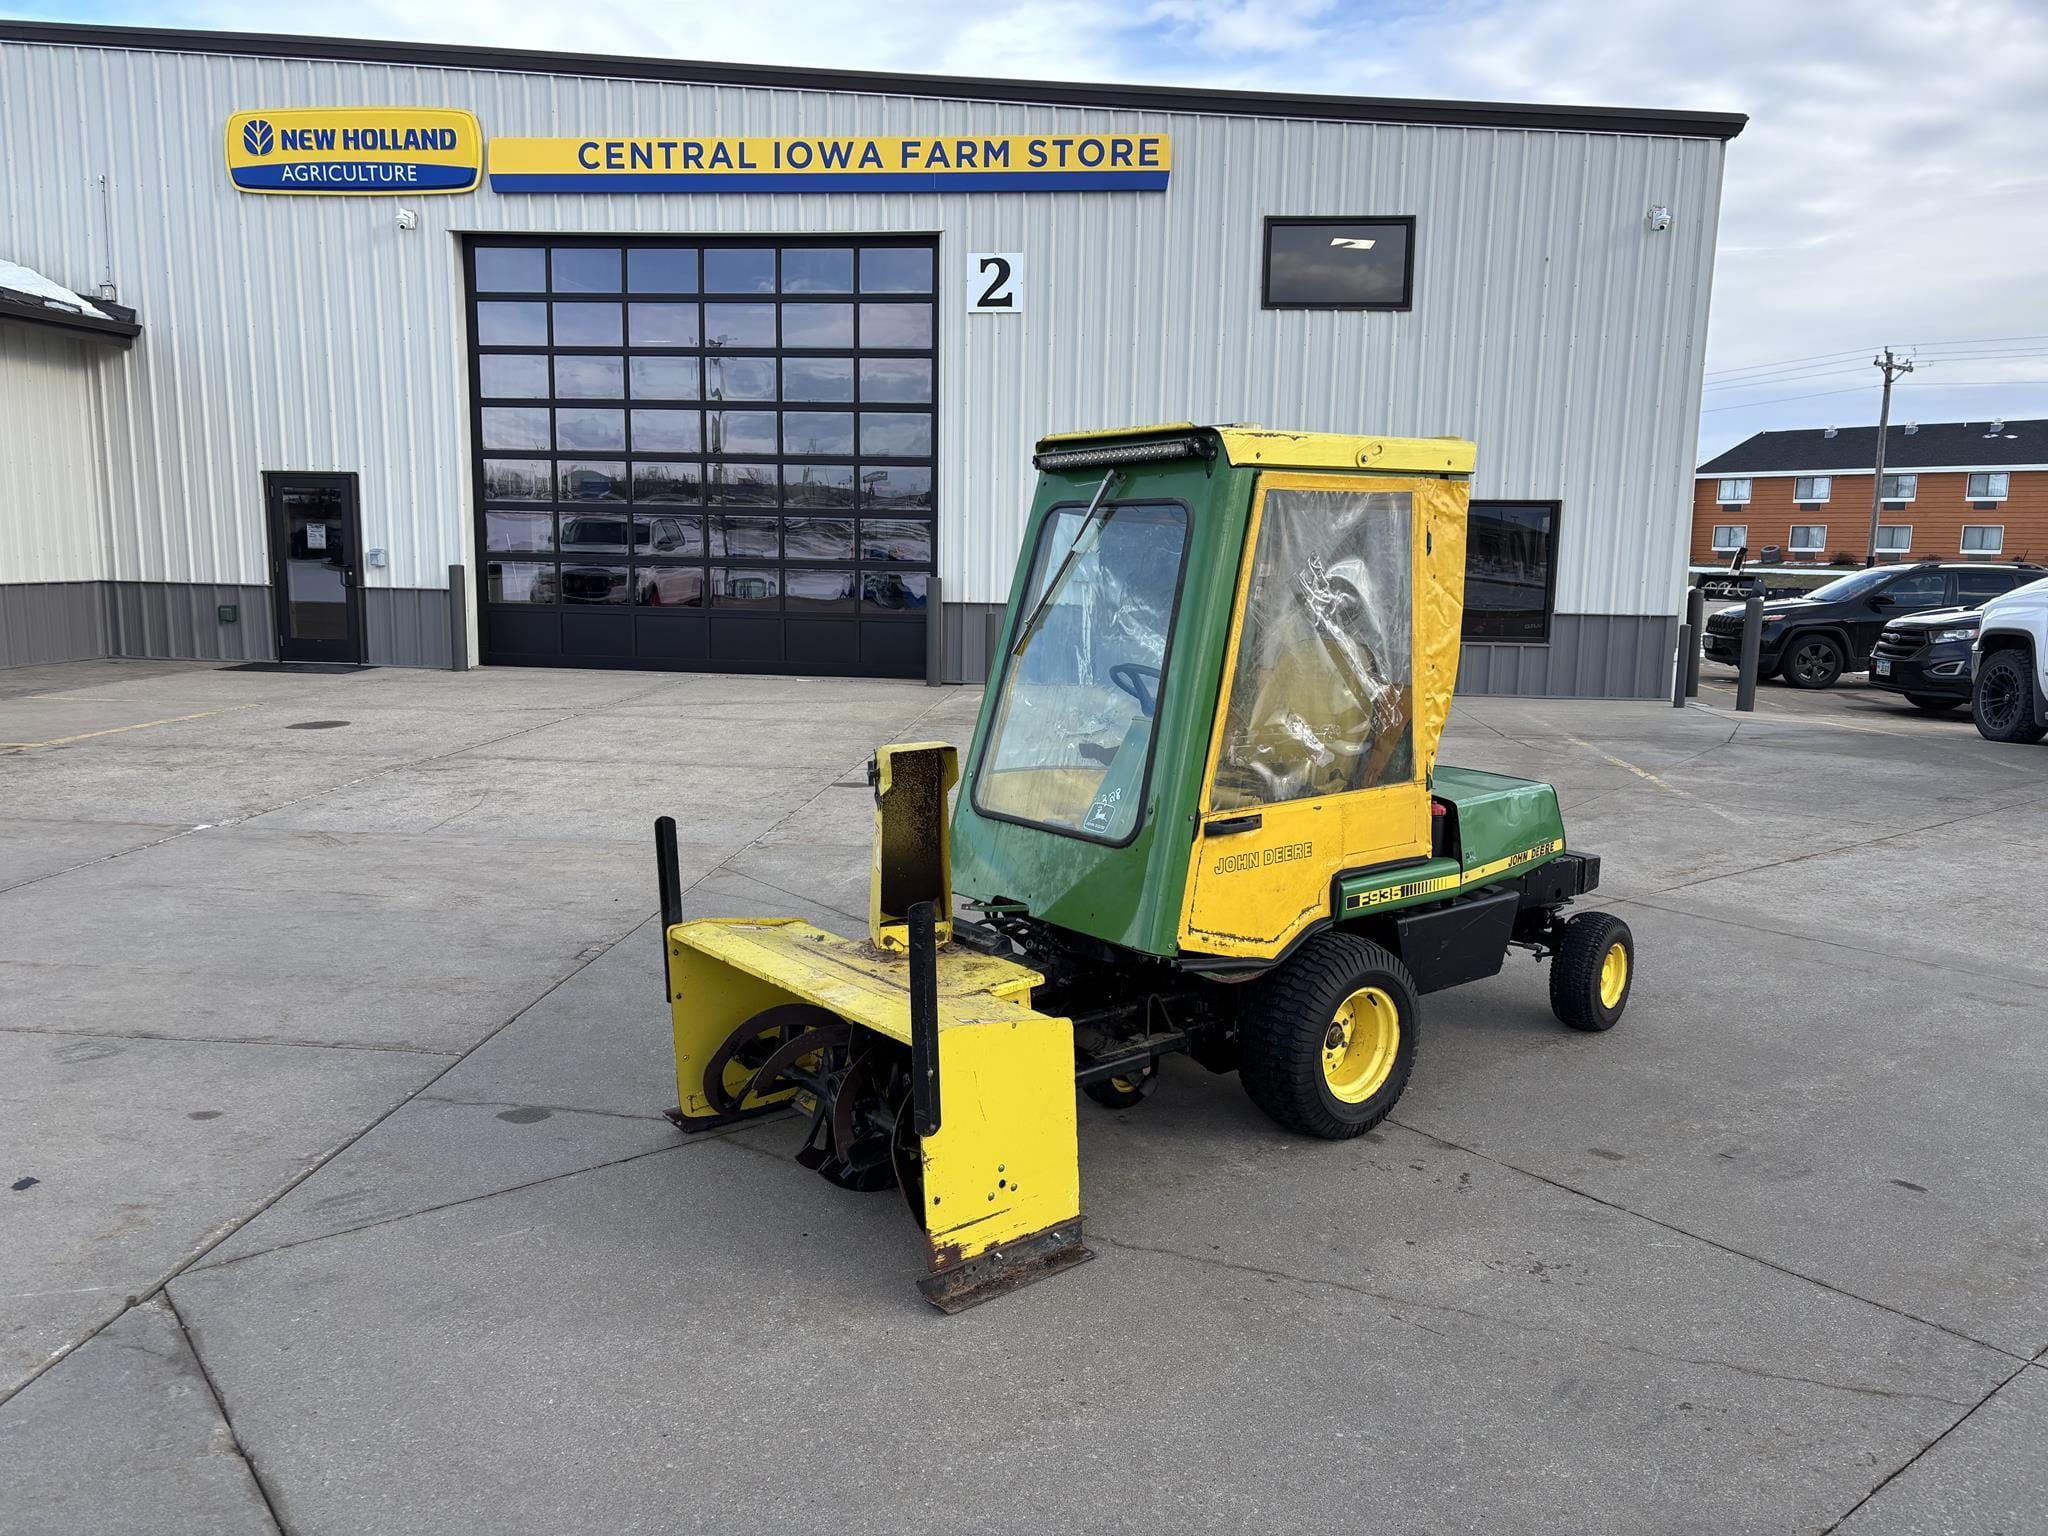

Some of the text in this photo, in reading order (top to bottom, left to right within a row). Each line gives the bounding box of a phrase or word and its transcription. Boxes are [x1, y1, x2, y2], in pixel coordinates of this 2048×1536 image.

[280, 128, 457, 150] NEW HOLLAND
[577, 137, 1160, 170] CENTRAL IOWA FARM STORE
[281, 164, 418, 182] AGRICULTURE
[976, 257, 1013, 308] 2
[1213, 841, 1313, 875] JOHN DEERE
[1507, 841, 1555, 868] JOHN DEERE
[1360, 885, 1402, 907] F935
